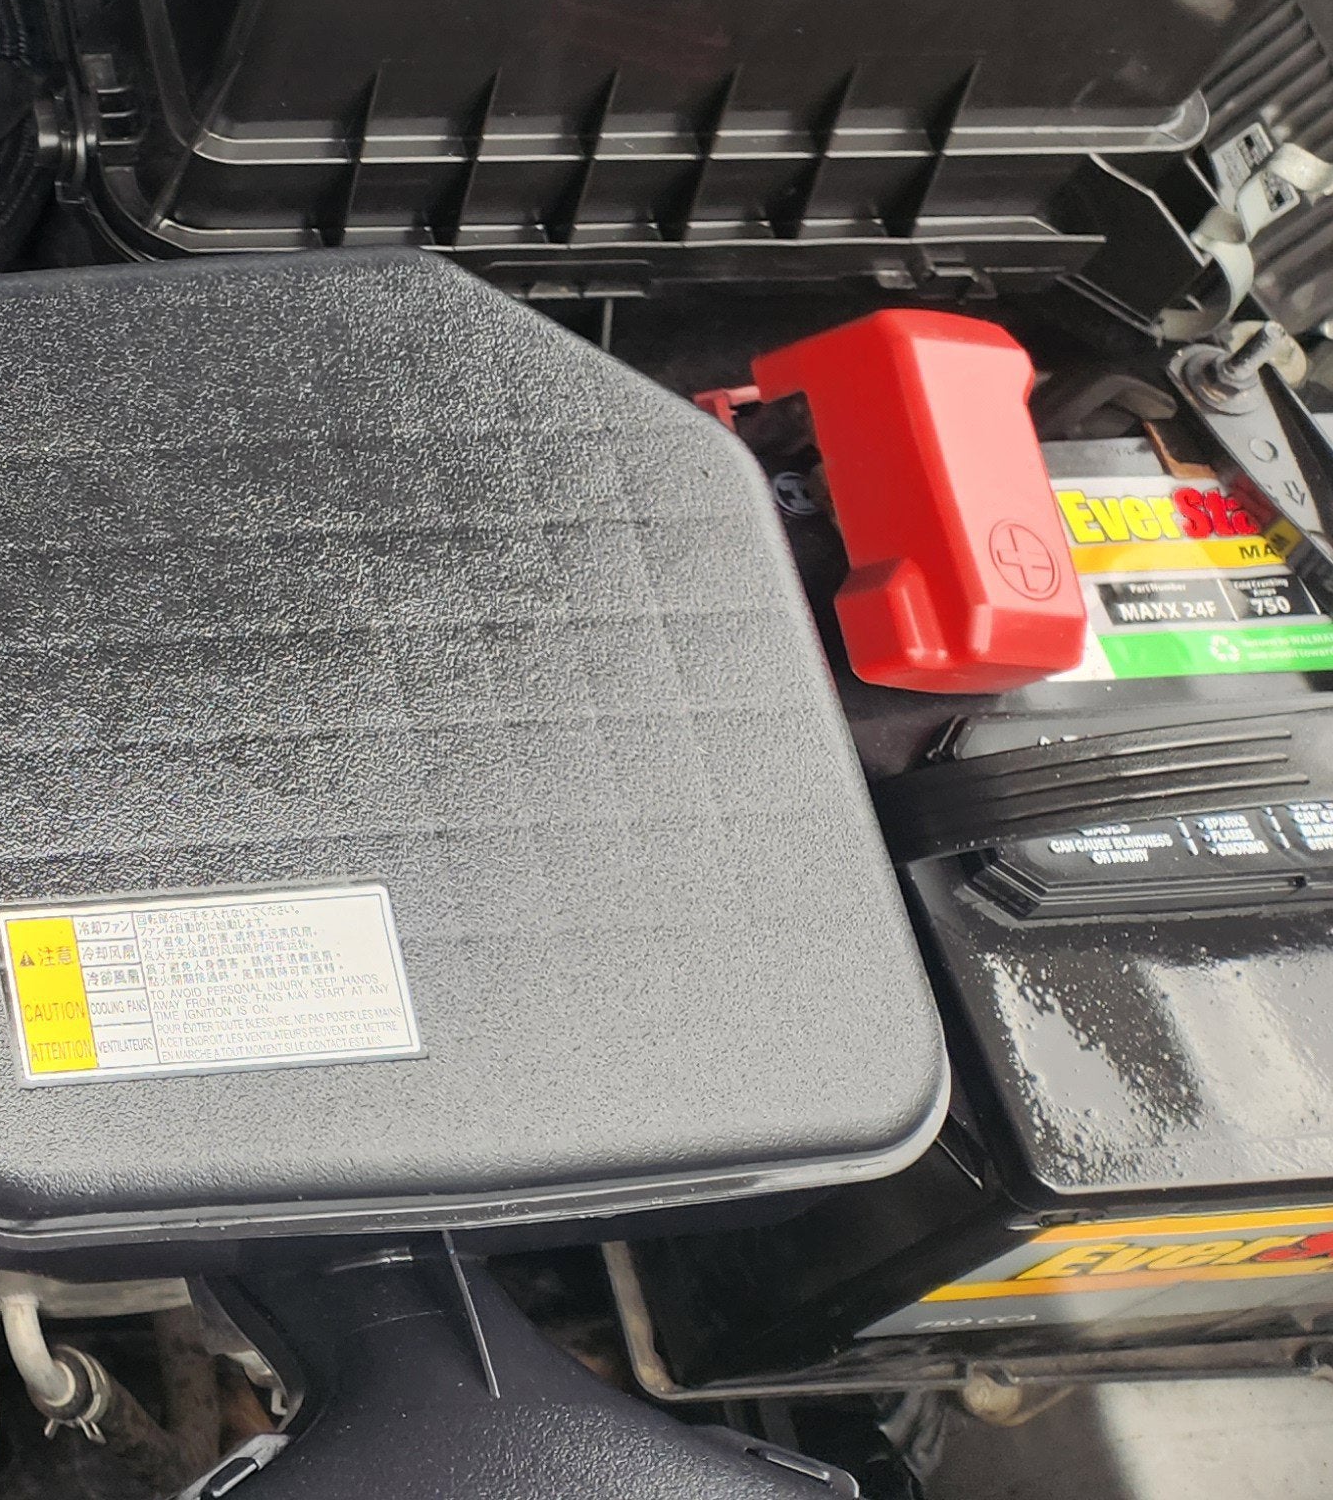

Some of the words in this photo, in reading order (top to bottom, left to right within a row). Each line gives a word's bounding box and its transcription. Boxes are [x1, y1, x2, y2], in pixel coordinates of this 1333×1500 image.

[1117, 601, 1180, 623] MAXX
[1183, 600, 1217, 619] 24F
[1250, 598, 1291, 617] 750
[1205, 814, 1250, 830] SPARKS
[1293, 810, 1320, 825] CAN
[1049, 839, 1076, 854] CAN
[1077, 837, 1114, 852] CAUSE
[1114, 833, 1174, 850] BLINDNESS
[1210, 828, 1255, 843] FLAMES
[1110, 848, 1149, 864] INJURY
[1216, 840, 1270, 856] SMOKING
[169, 986, 202, 999] AVOID
[206, 982, 263, 996] PERSONAL
[341, 974, 379, 986] HANDS
[151, 999, 181, 1010] AWAY
[184, 997, 216, 1008] FROM
[255, 992, 283, 1002] FANS
[287, 990, 309, 1000] MAY
[313, 987, 346, 998] START
[368, 984, 390, 994] ANY
[23, 1000, 86, 1022] CAUTION
[89, 1000, 124, 1015] COOLING
[127, 999, 147, 1012] FANS
[154, 1010, 179, 1022] TIME
[183, 1006, 232, 1019] IGNITION
[156, 1023, 182, 1035] POUR
[307, 1012, 325, 1023] PAS
[326, 1010, 356, 1022] POSER
[356, 1009, 374, 1020] LES
[29, 1038, 93, 1062] ATTENTION
[96, 1037, 154, 1053] VENTILATEURS
